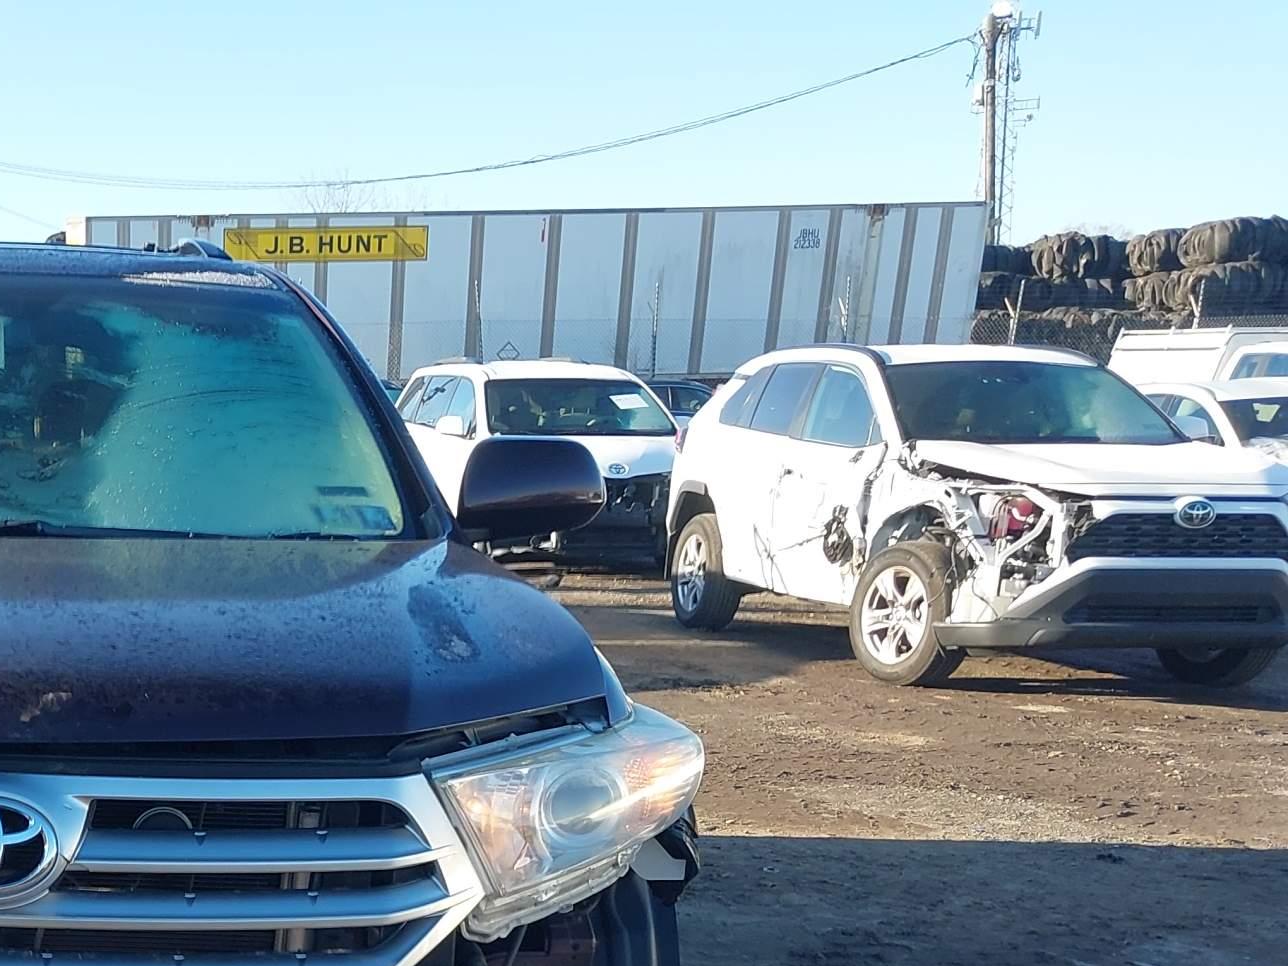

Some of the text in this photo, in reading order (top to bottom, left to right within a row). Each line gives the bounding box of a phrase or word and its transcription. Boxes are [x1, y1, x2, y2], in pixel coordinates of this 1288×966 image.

[796, 228, 820, 240] JBHU
[265, 234, 388, 254] J.B. HUNT
